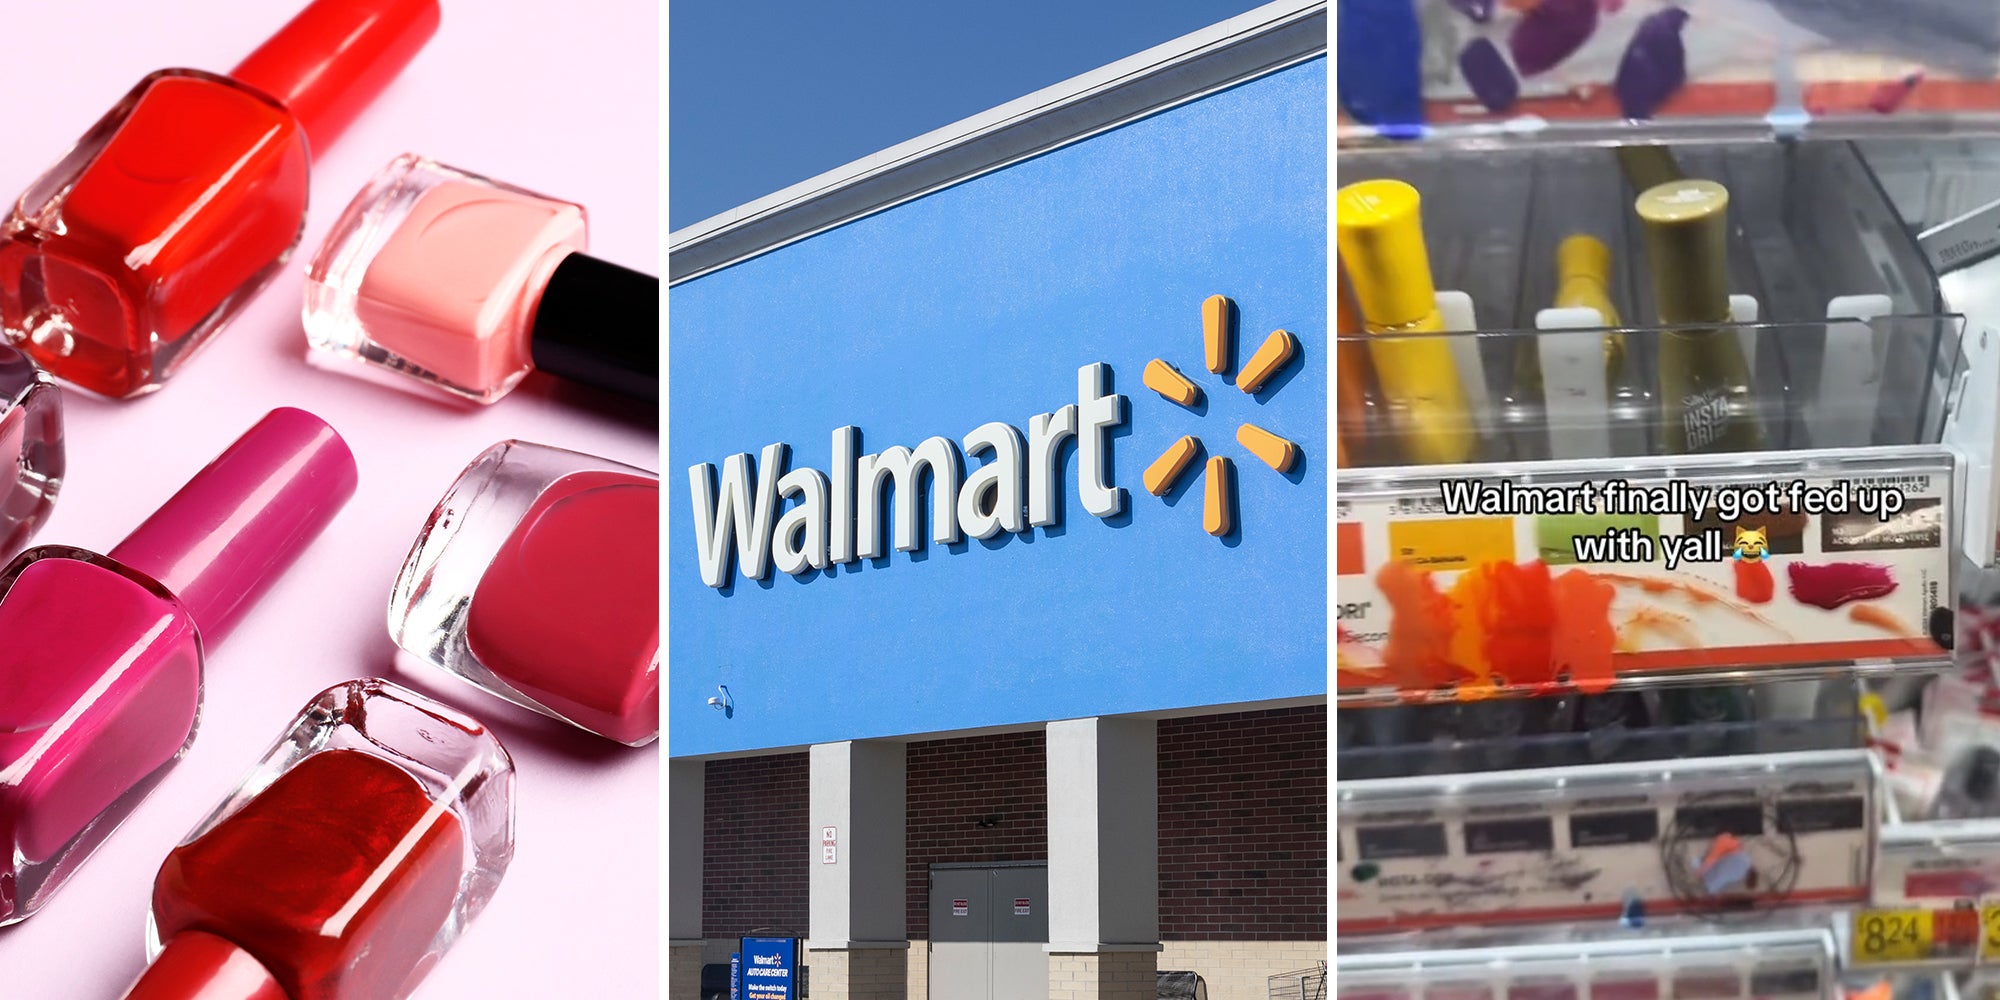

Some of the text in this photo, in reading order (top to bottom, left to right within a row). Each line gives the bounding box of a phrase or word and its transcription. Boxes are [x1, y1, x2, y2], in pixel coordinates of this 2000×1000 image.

[1683, 396, 1729, 433] INSTA
[688, 361, 1122, 589] Walmart
[753, 955, 774, 964] Walmart
